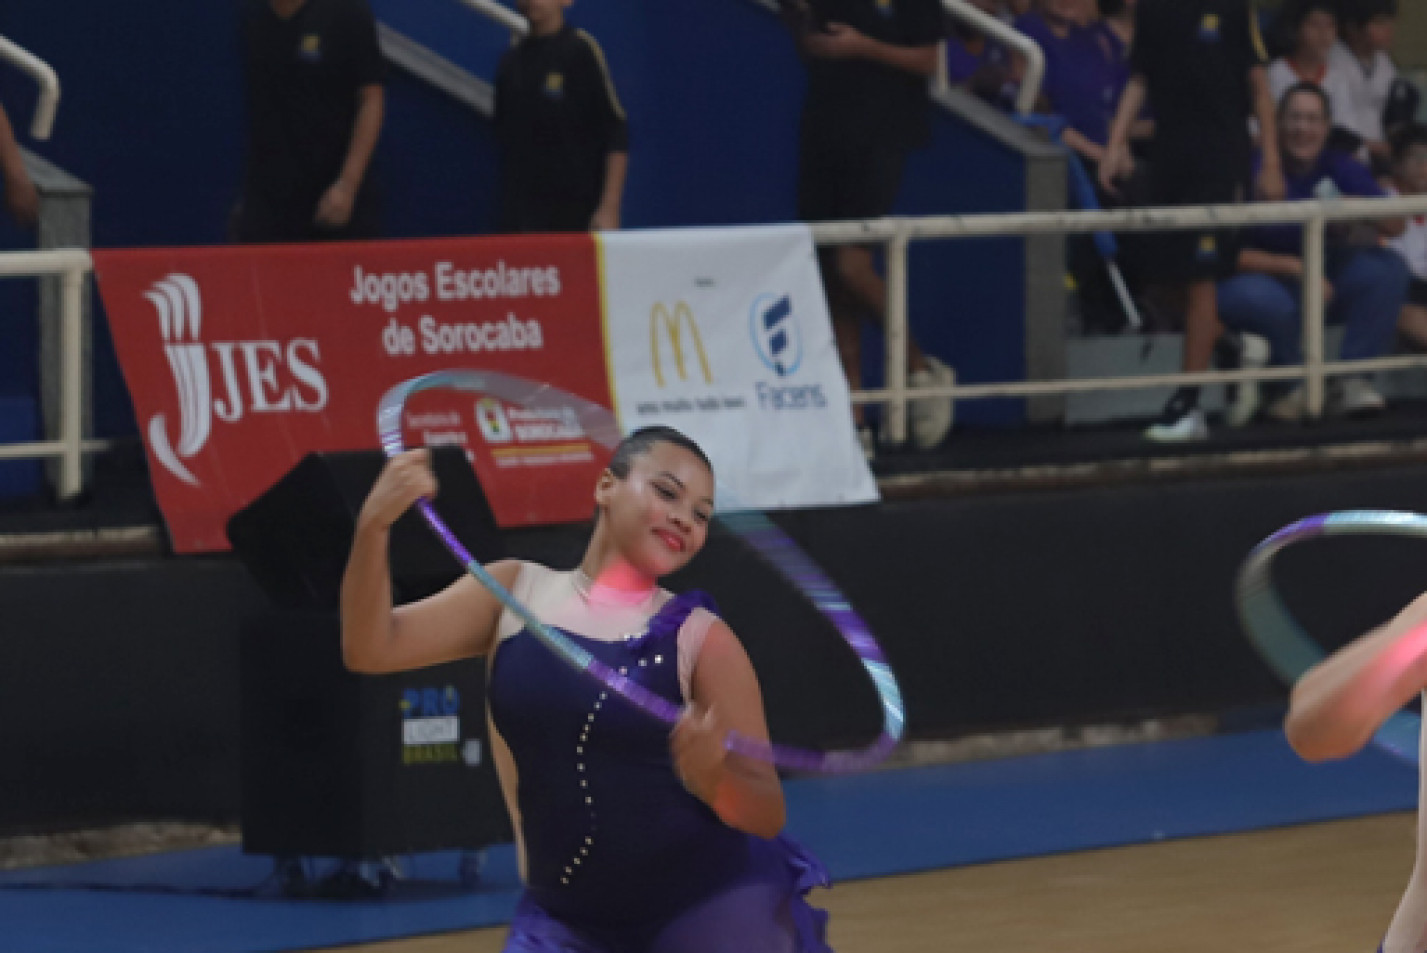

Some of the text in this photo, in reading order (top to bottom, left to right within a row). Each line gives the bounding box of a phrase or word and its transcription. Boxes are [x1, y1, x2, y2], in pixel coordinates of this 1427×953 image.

[351, 259, 561, 312] Jogos Escolares
[382, 311, 544, 355] de Sorocaba
[211, 337, 328, 422] JES
[755, 382, 828, 410] Facens
